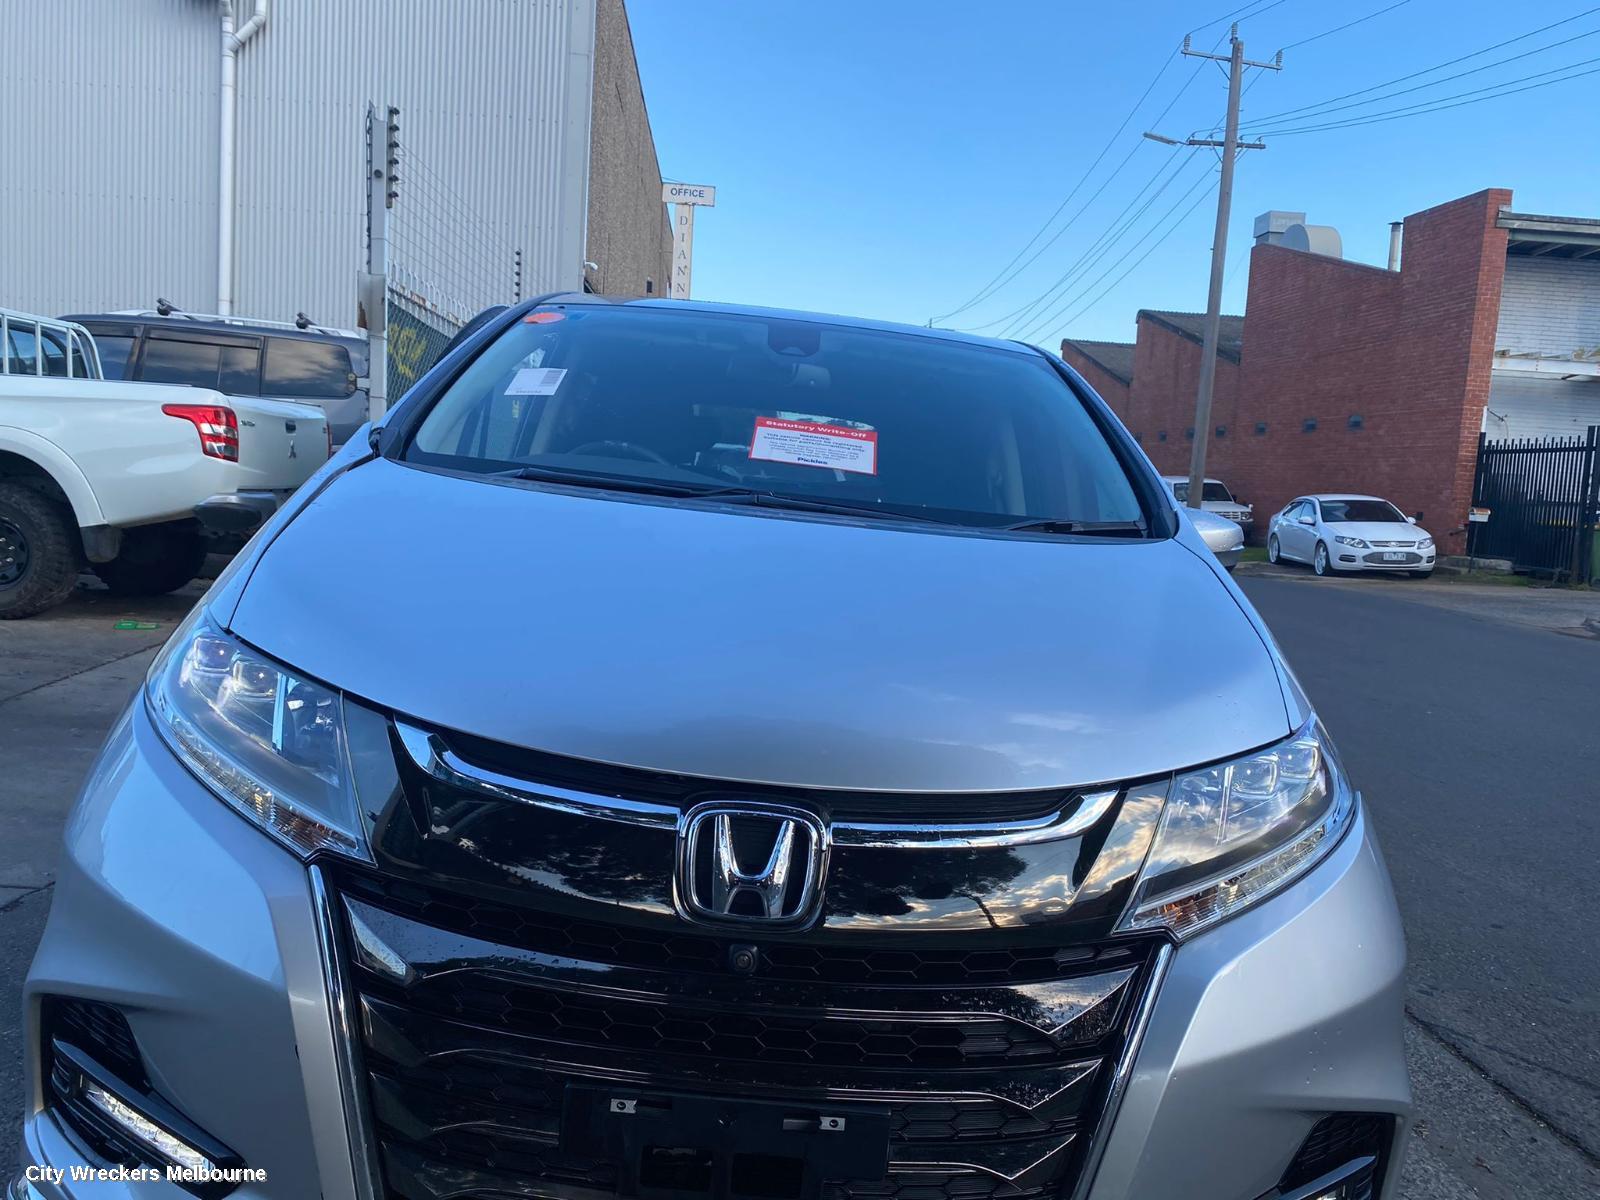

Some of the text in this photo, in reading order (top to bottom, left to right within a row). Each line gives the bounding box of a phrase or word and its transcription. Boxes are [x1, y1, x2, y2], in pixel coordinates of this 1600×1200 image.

[670, 187, 704, 198] OFFICE
[676, 215, 688, 293] DIANN
[766, 420, 867, 438] Statutory Write-Off
[797, 457, 828, 465] Pickles
